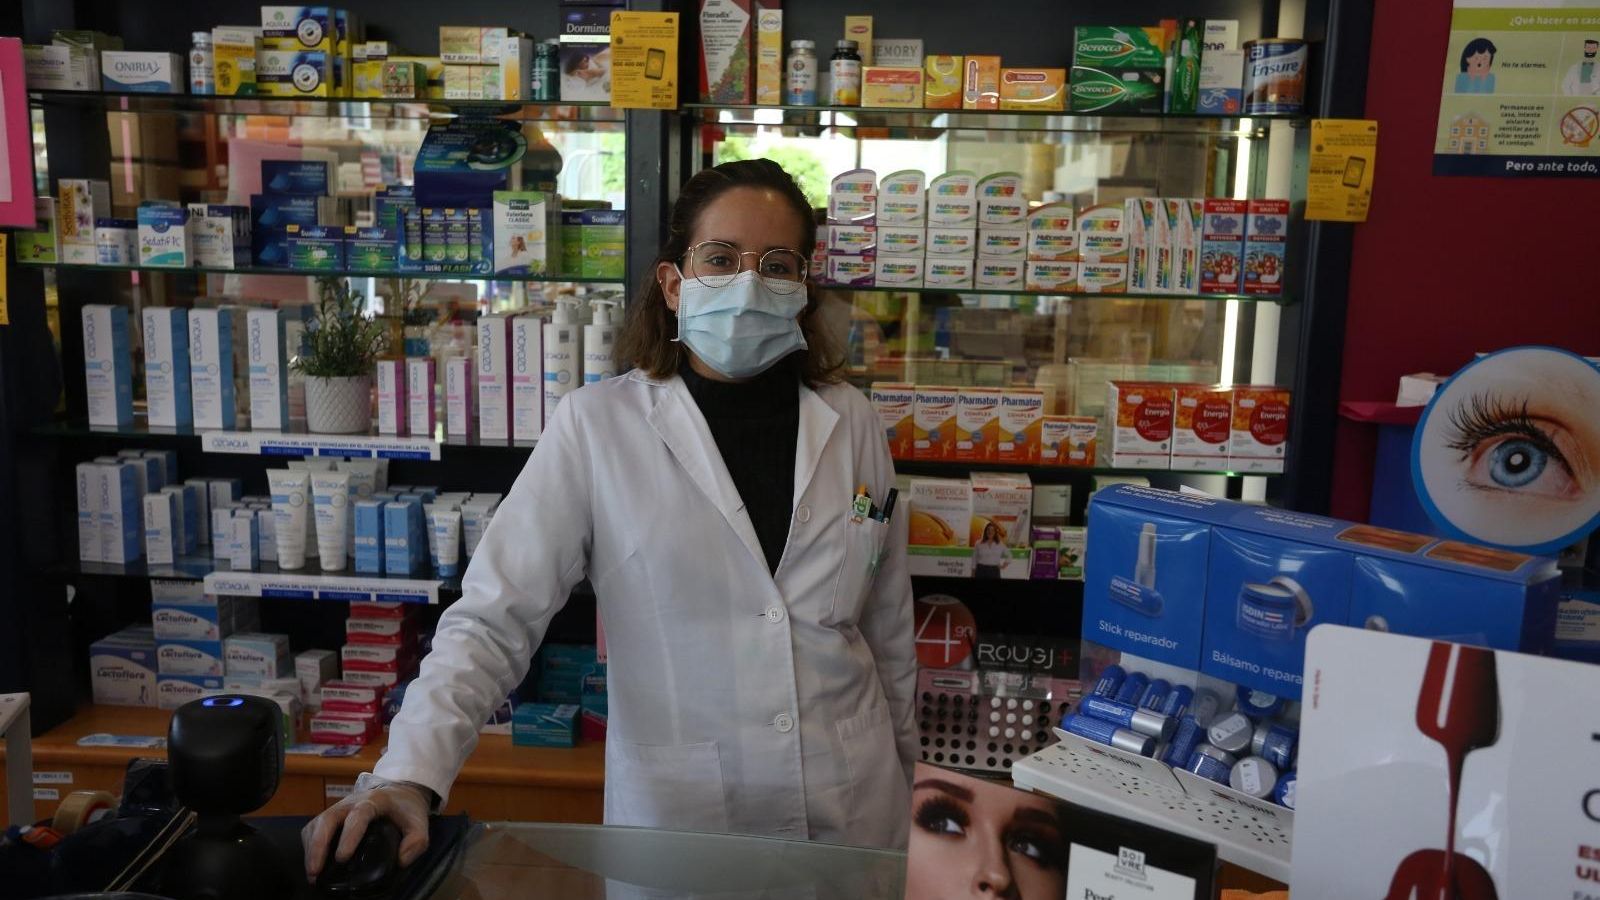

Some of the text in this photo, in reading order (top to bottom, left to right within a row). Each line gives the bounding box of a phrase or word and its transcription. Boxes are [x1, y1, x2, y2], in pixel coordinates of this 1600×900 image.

[1510, 14, 1534, 27] ¿Qué
[1537, 15, 1564, 25] hacer
[1566, 17, 1578, 25] en
[1077, 42, 1122, 53] Berocca
[115, 61, 153, 72] ONIRIA
[1252, 62, 1298, 77] Ensure
[1075, 85, 1113, 94] Berocca
[1505, 161, 1598, 174] Pero ante todo,
[873, 392, 913, 404] Pharmaton
[915, 393, 955, 405] Pharmaton
[958, 394, 998, 406] Pharmaton
[1001, 395, 1041, 407] Pharmaton
[1043, 422, 1069, 431] Pharmaton
[1070, 422, 1097, 431] Pharmaton
[935, 487, 968, 497] MEDICAL
[995, 491, 1027, 501] MEDICAL
[156, 614, 198, 624] Lactoflora
[915, 605, 961, 664] 4
[1098, 620, 1179, 650] Stick reparador
[161, 650, 202, 660] Lactoflora
[228, 653, 264, 662] Lactoflora
[1212, 649, 1259, 674] Bálsamo
[97, 667, 145, 680] Lactoflora
[160, 684, 202, 695] Lactoflora
